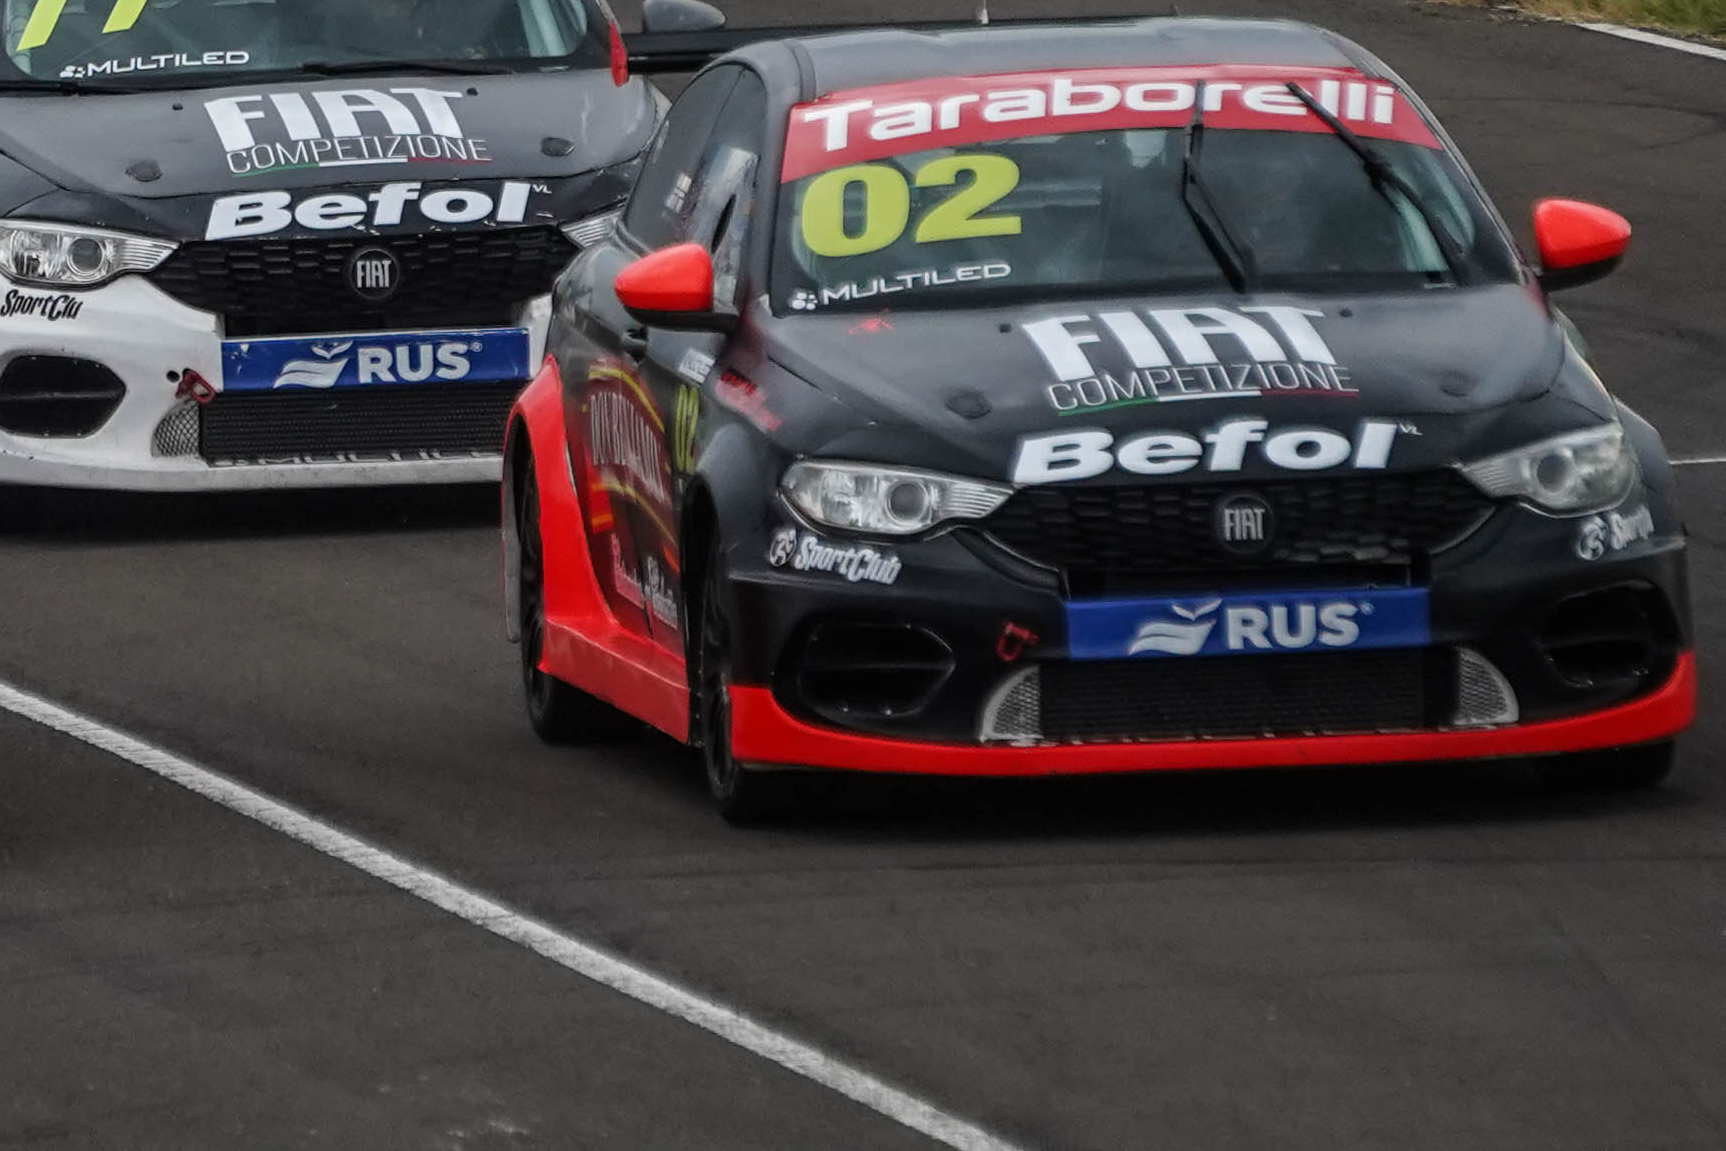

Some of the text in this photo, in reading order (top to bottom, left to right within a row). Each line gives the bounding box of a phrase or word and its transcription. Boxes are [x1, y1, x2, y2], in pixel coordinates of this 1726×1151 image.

[87, 49, 250, 78] MULTILED
[202, 86, 467, 152] FIAT
[803, 77, 1396, 153] Taraborelli
[226, 133, 492, 174] COMPETIZIONE
[204, 181, 531, 242] Befol
[801, 153, 1022, 259] 02
[355, 258, 392, 288] FIAT
[821, 258, 1012, 307] MULTILED
[1020, 305, 1340, 384] FIAT
[1047, 361, 1359, 412] COMPETIZIONE
[1007, 419, 1398, 485] Befol
[1223, 505, 1266, 542] FIAT
[793, 535, 903, 586] SportClub
